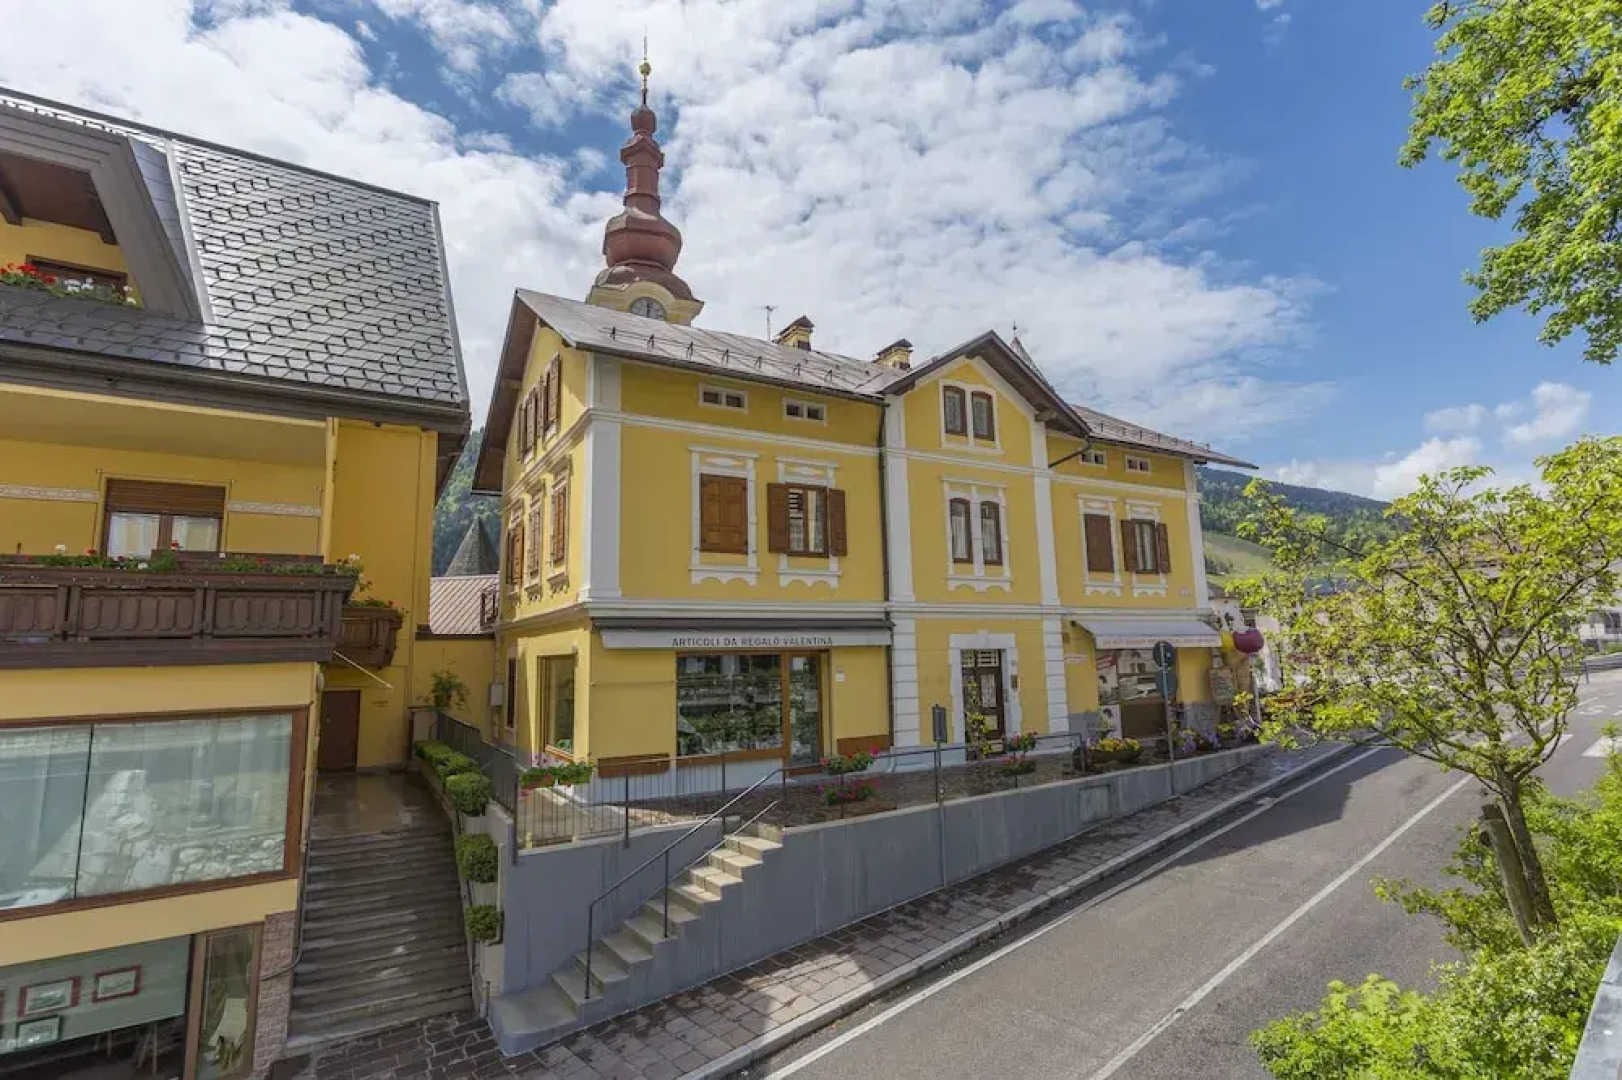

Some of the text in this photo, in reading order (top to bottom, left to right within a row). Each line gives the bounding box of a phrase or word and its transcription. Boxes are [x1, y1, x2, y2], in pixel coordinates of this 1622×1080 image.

[671, 638, 720, 647] ARTICOLI
[723, 638, 738, 647] DA
[782, 636, 834, 646] VALENTINA
